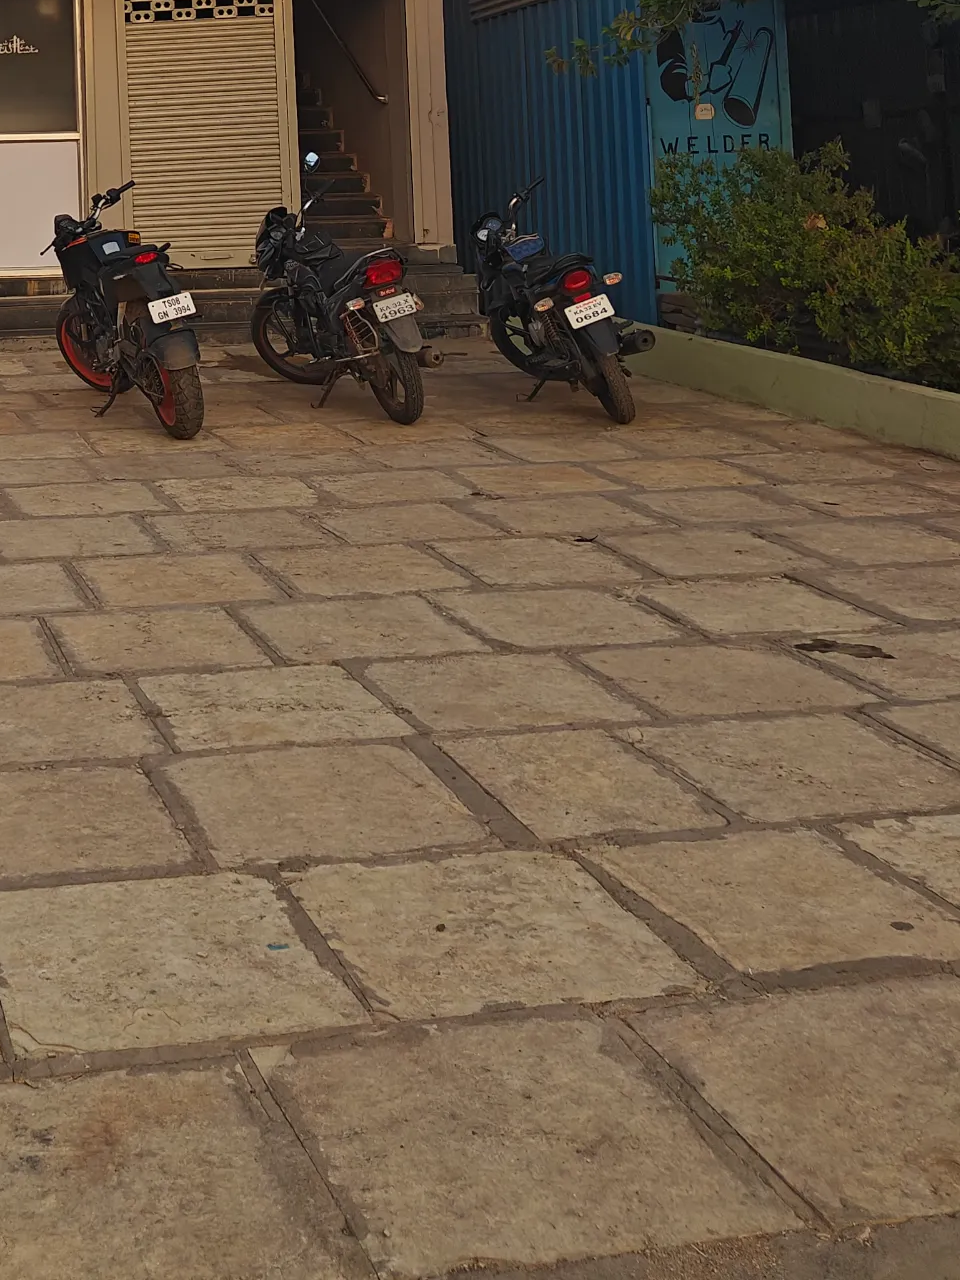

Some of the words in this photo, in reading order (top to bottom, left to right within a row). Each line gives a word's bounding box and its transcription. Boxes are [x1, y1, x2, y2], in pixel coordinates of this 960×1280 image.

[660, 133, 770, 155] WELDER
[162, 296, 181, 309] TS08
[157, 310, 170, 320] GN
[173, 304, 191, 316] 3994
[380, 304, 415, 320] 4963
[575, 307, 608, 324] 0684
